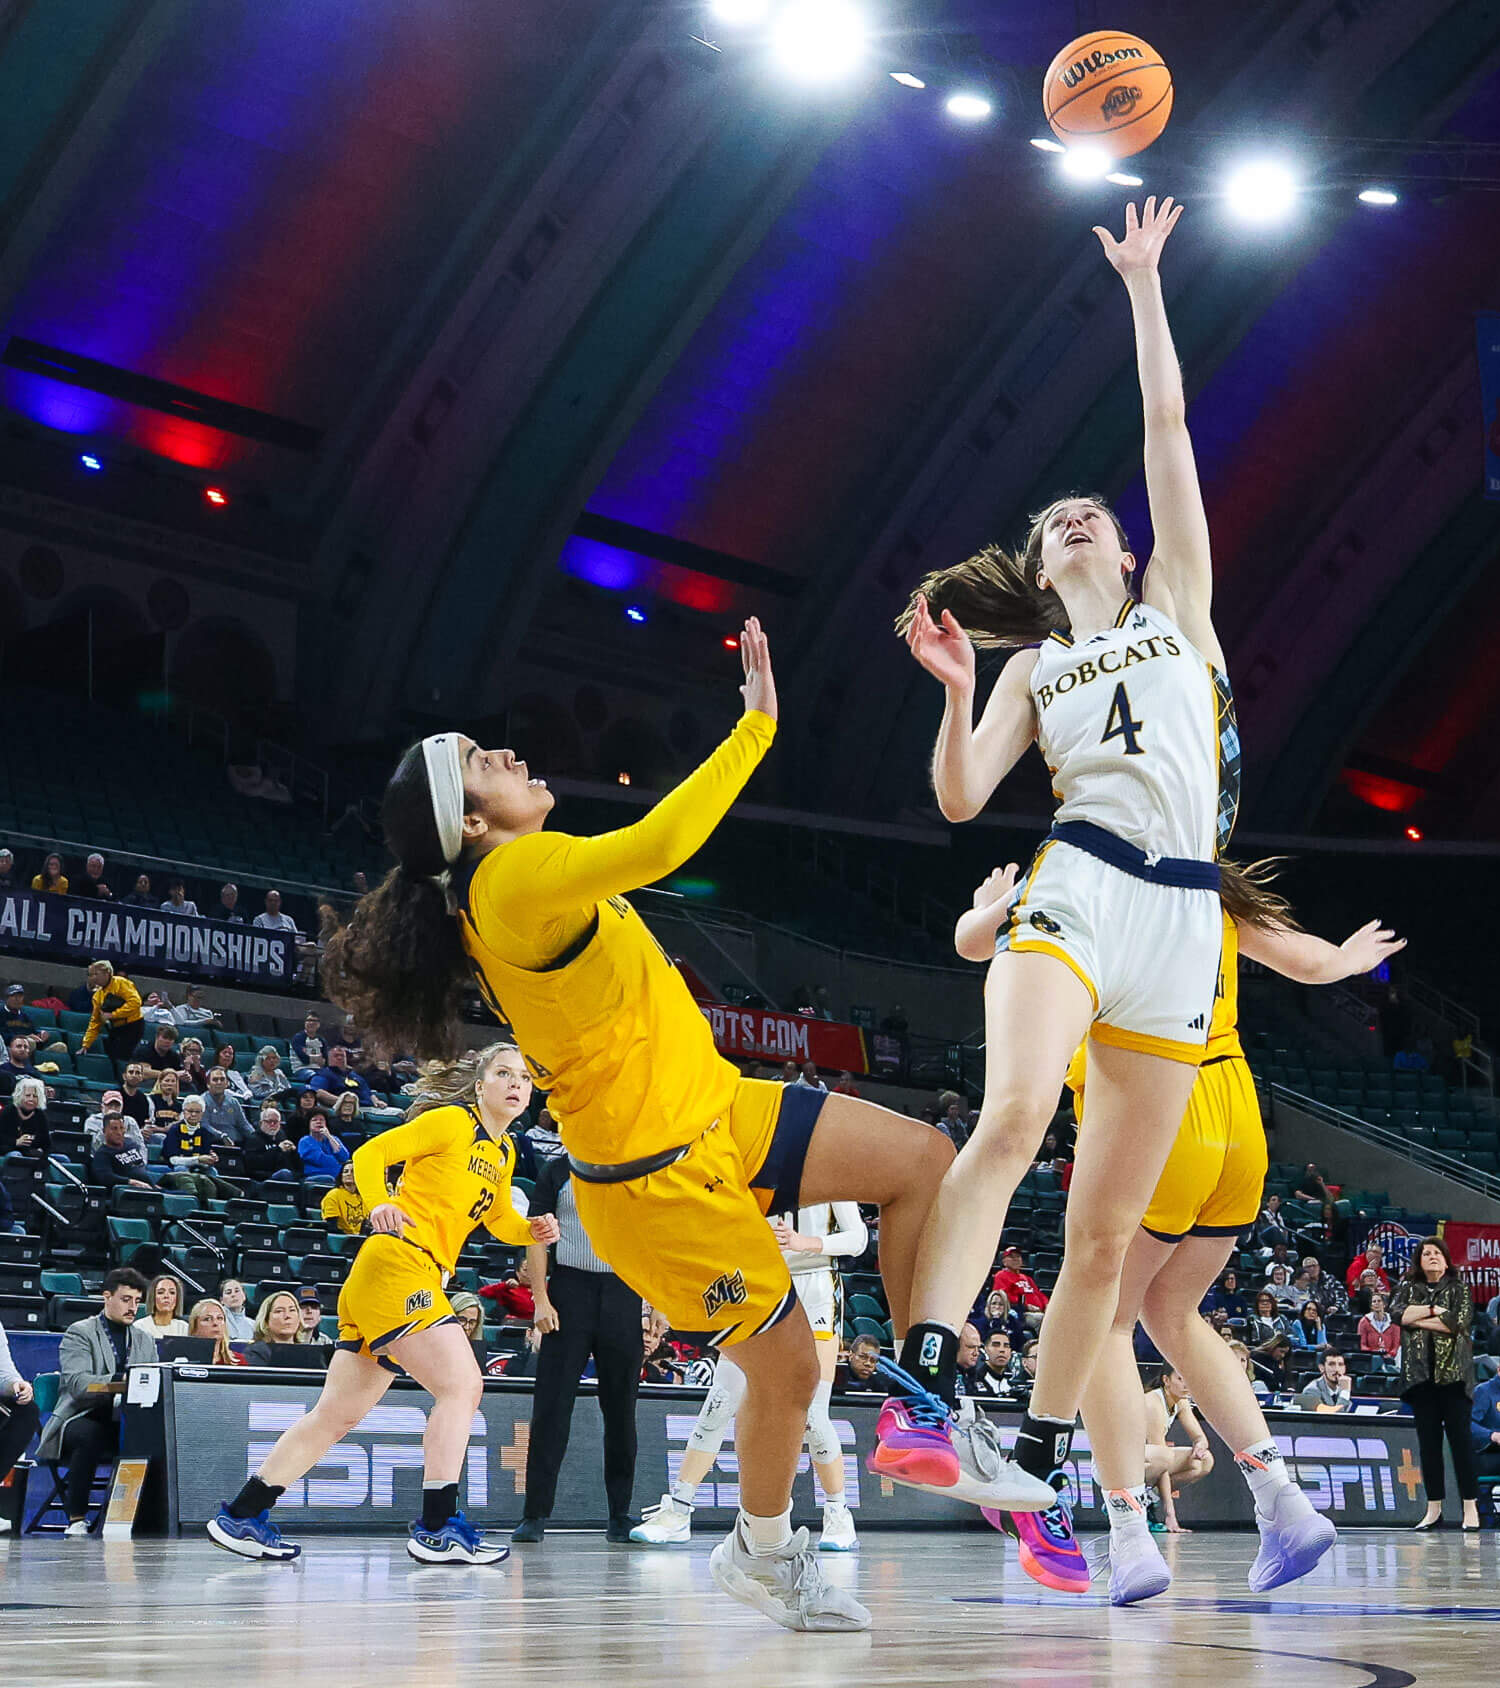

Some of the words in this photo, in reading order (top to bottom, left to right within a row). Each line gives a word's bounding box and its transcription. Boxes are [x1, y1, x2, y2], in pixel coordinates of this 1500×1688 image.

[1059, 45, 1145, 89] Wilson
[1036, 635, 1181, 710] BOBCATS
[1100, 681, 1146, 755] 4
[67, 907, 286, 977] CHAMPIONSHIPS
[468, 1187, 495, 1221] 22
